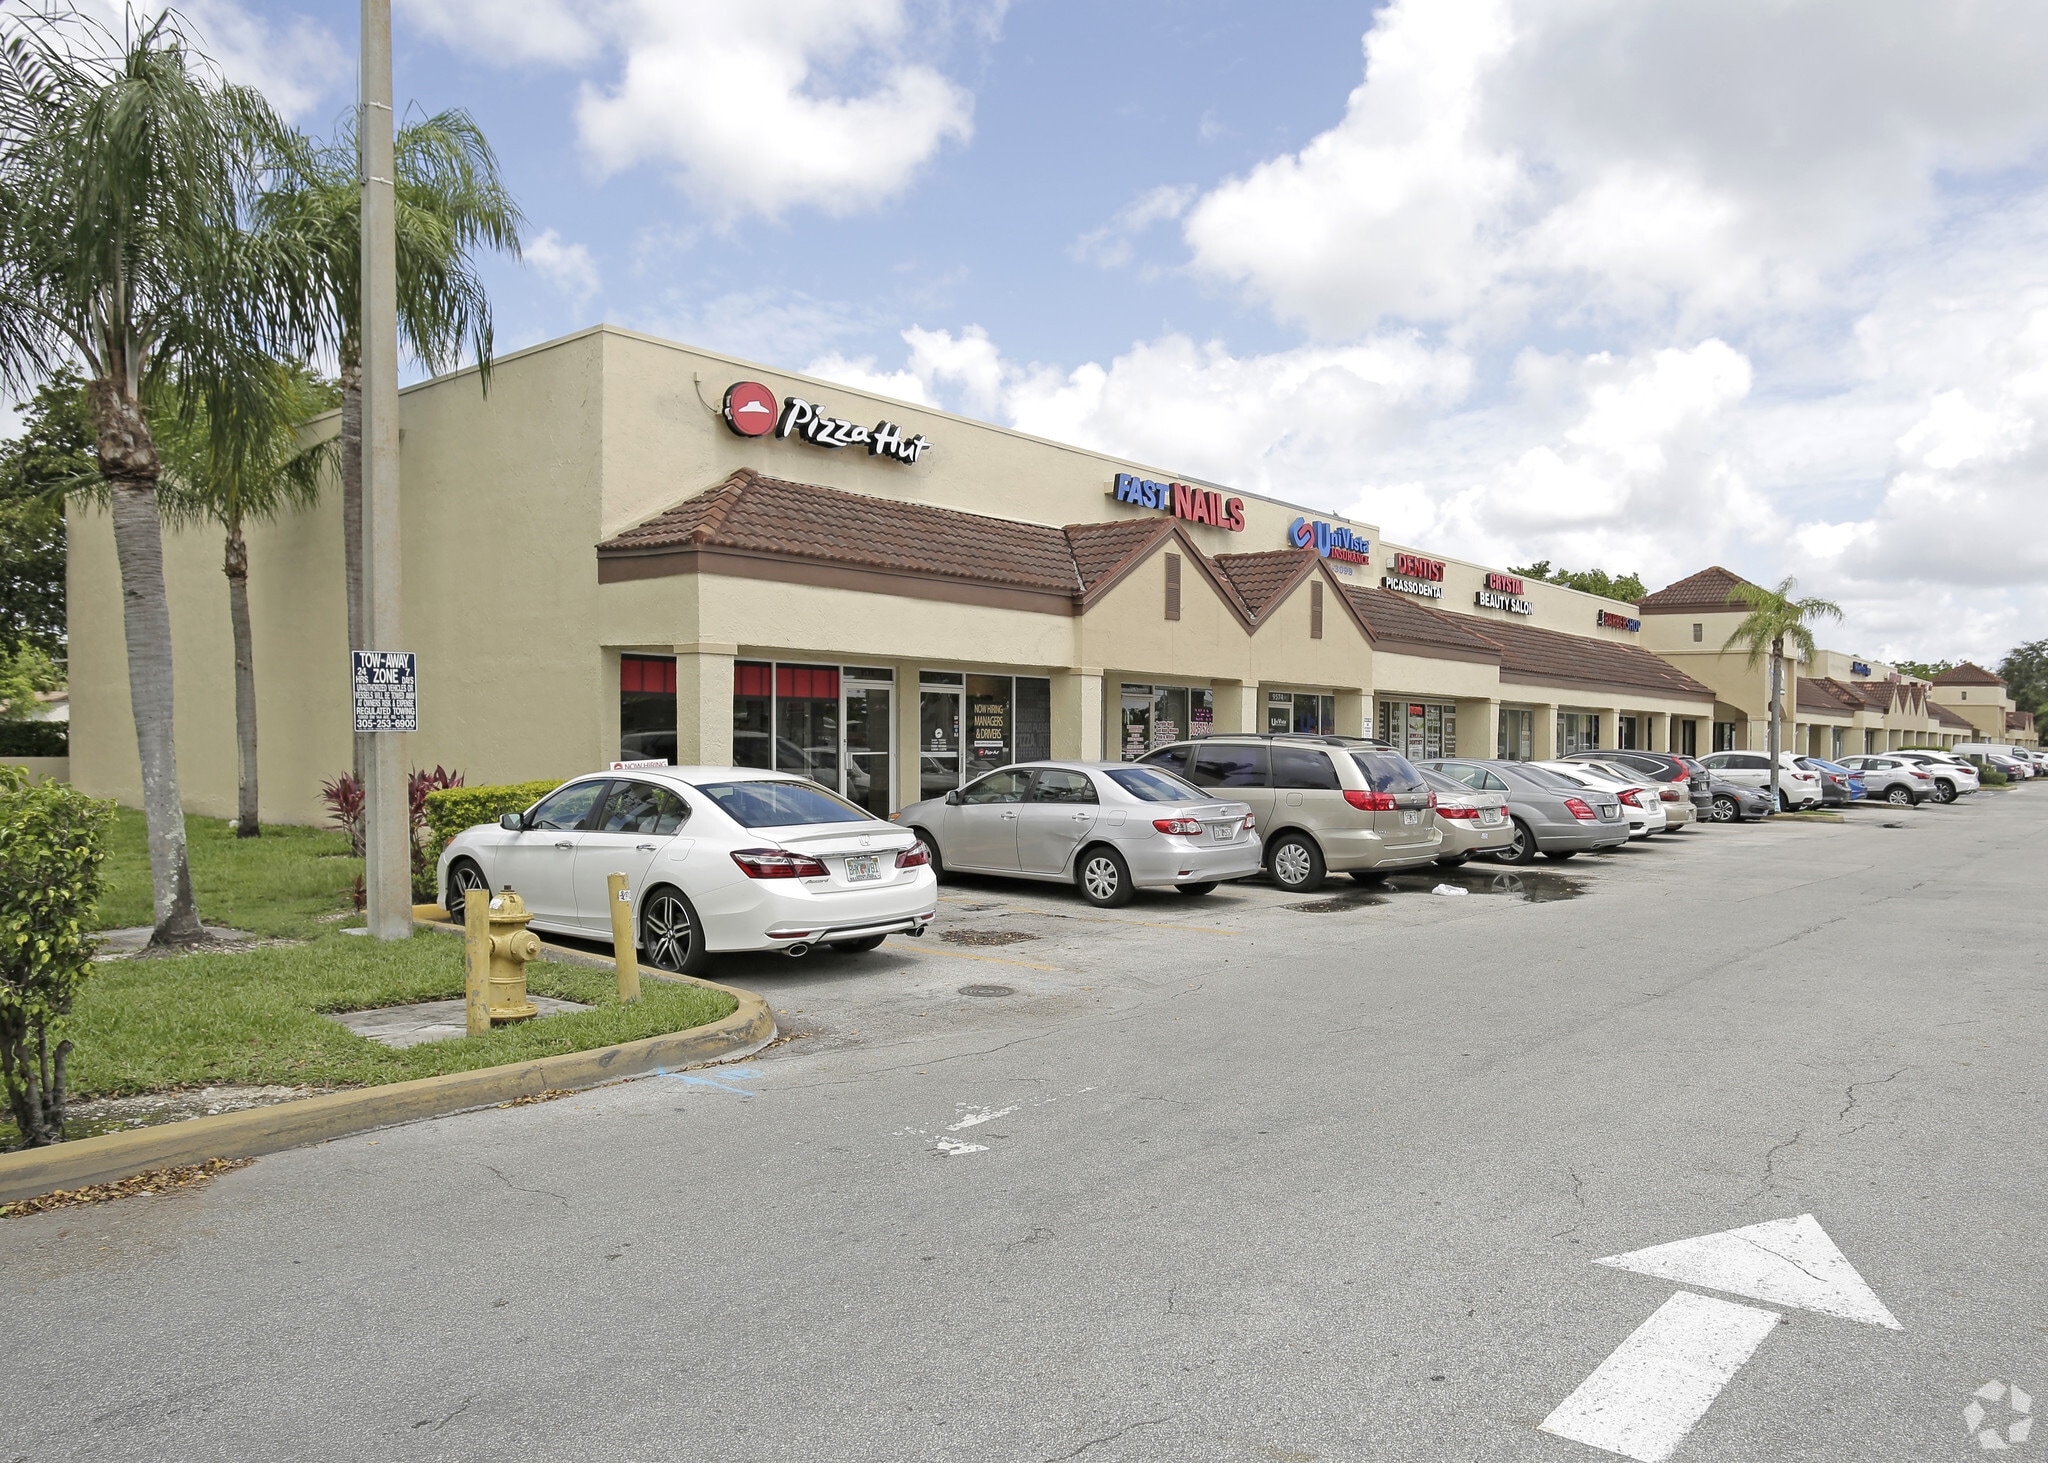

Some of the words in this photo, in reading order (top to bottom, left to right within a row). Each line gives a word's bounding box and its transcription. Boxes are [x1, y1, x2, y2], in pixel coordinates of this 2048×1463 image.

[778, 397, 871, 447] Pizza
[871, 421, 934, 464] Hut
[1115, 473, 1169, 510] FAST
[1170, 483, 1245, 532] NAILS
[1312, 521, 1370, 558] UniVista
[1331, 548, 1369, 565] INSURANCE
[1396, 553, 1446, 582] DENTIST
[1385, 577, 1418, 594] PICASSO
[1418, 583, 1444, 599] DENTAL
[1488, 573, 1524, 595] CRYSTAL
[1479, 592, 1509, 610] BEAUTY
[1511, 598, 1534, 615] SALON
[359, 653, 409, 668] TOW-AWAY
[357, 667, 366, 676] 24
[373, 668, 399, 684] ZONE
[404, 668, 411, 677] 7
[355, 675, 369, 684] HRS
[401, 676, 414, 685] DAYS
[356, 706, 391, 716] REGULATED
[392, 708, 416, 716] TOWING
[974, 704, 987, 713] NOW
[987, 704, 1003, 714] HIRING
[356, 719, 416, 728] 305-253-6900
[974, 716, 1003, 726] MANAGERS
[976, 728, 981, 739] &
[981, 728, 1002, 739] DRIVERS
[643, 760, 668, 768] HIRING
